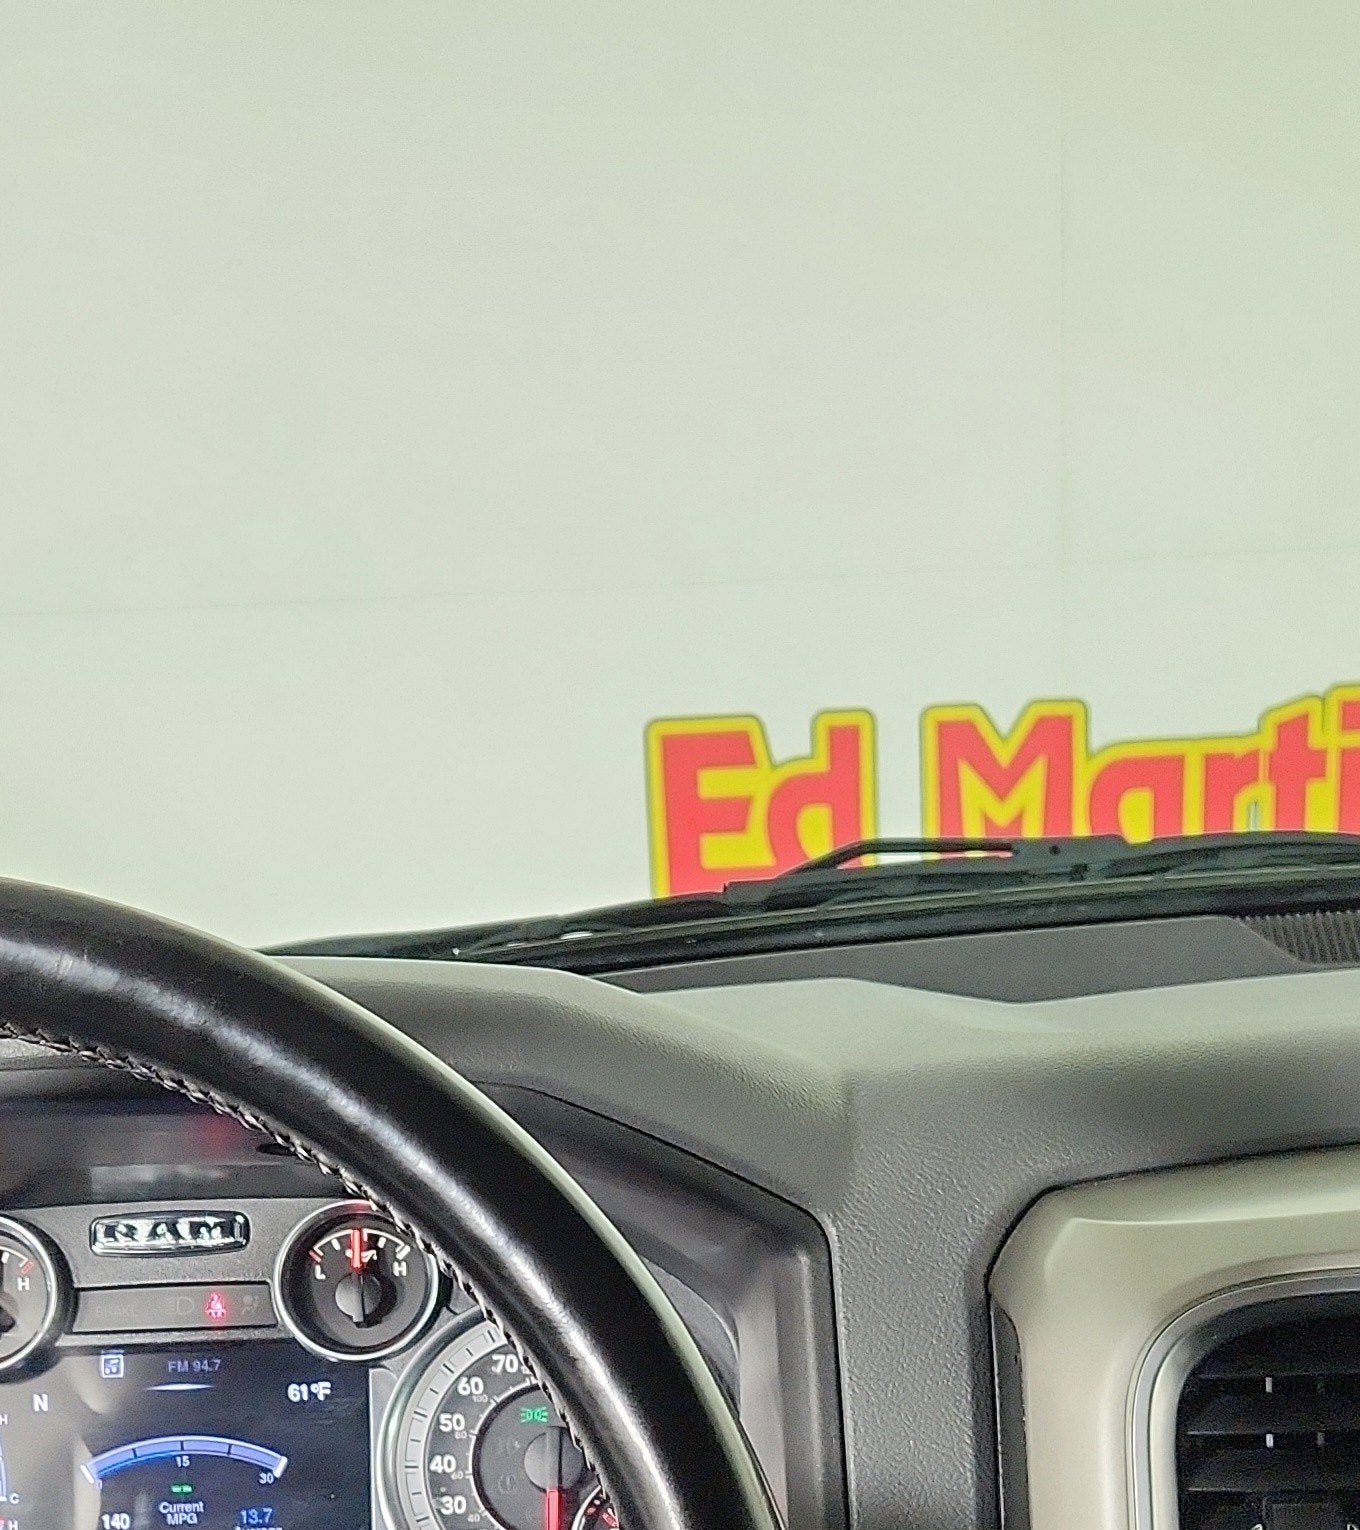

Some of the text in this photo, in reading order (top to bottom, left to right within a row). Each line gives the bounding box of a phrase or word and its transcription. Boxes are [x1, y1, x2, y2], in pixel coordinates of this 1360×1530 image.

[646, 709, 875, 899] Ed
[96, 1217, 238, 1250] RAM
[315, 1267, 326, 1280] L
[392, 1261, 407, 1276] H
[18, 1278, 29, 1291] H
[168, 1359, 221, 1373] FM 94.7
[492, 1354, 518, 1373] 70
[458, 1376, 484, 1396] 60
[34, 1394, 48, 1412] N
[0, 1415, 8, 1425] H
[440, 1412, 465, 1432] 50
[175, 1455, 190, 1468] 15
[430, 1454, 456, 1473] 40
[259, 1472, 274, 1485] 30
[159, 1501, 204, 1514] Current
[441, 1495, 467, 1515] 30
[102, 1513, 130, 1530] 140
[166, 1513, 197, 1525] MPG
[240, 1507, 273, 1524] 13.7
